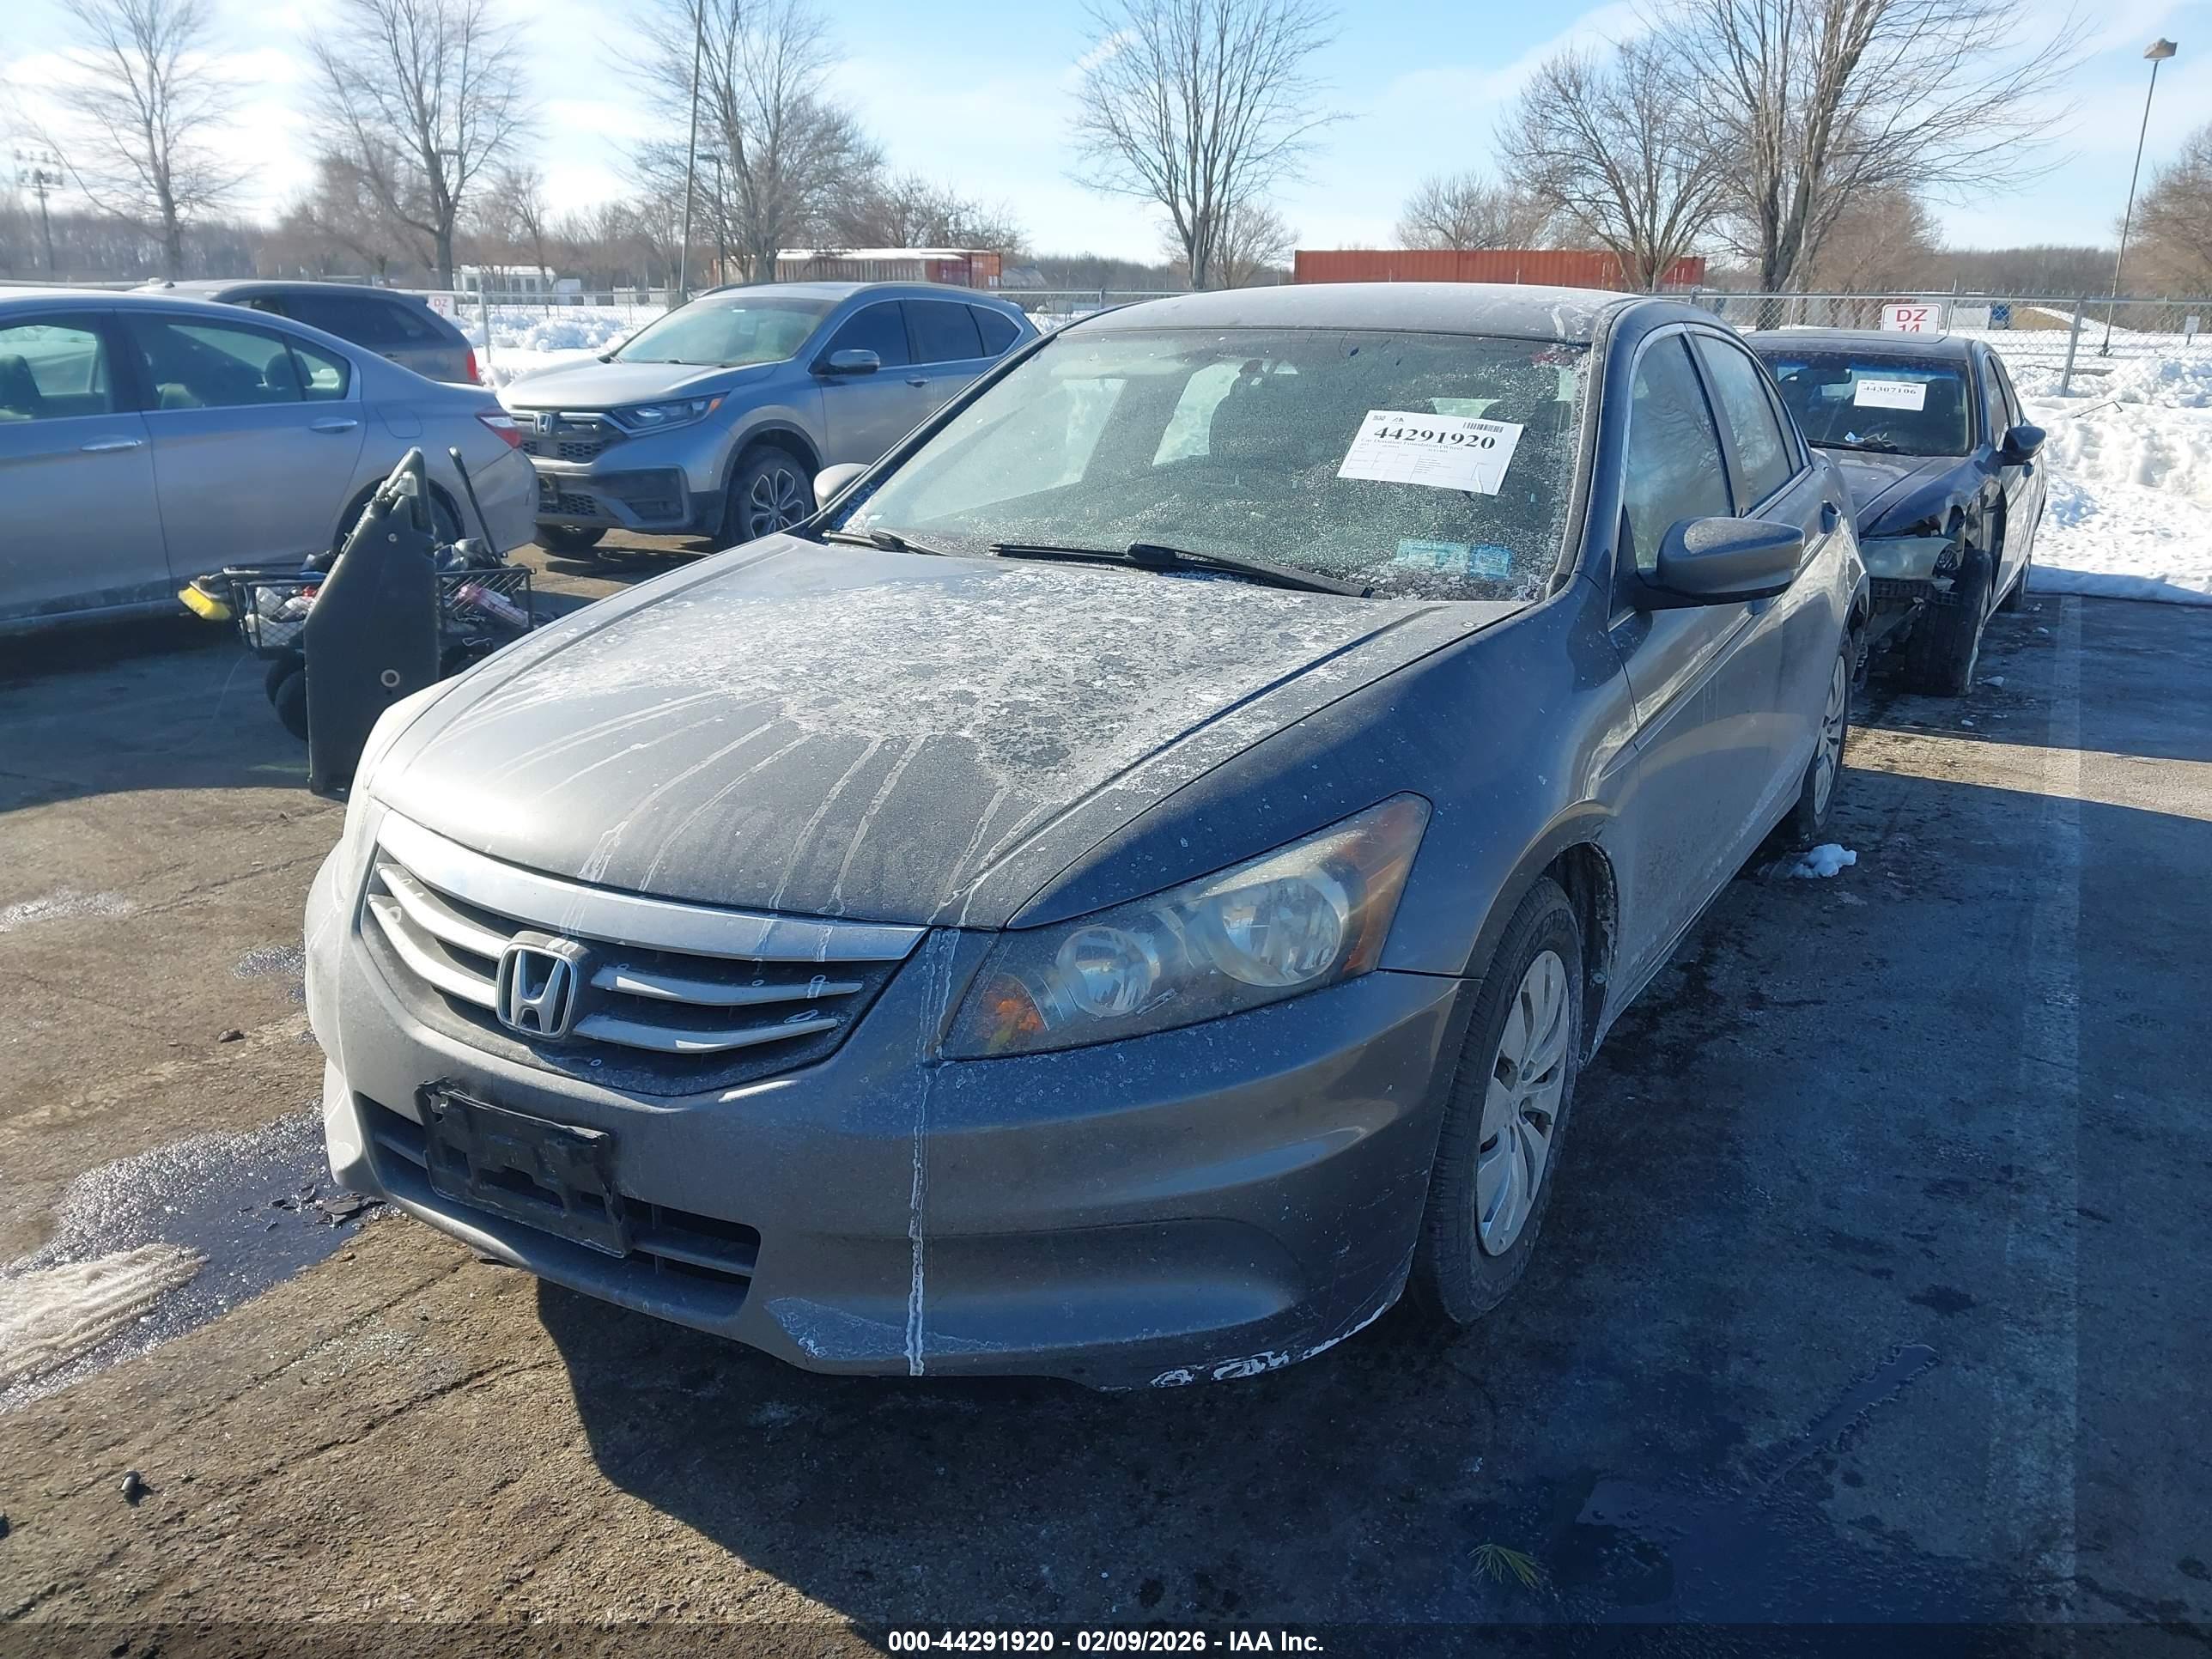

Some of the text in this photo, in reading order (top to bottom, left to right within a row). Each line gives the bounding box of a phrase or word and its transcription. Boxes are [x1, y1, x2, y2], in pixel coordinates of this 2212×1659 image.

[1896, 309, 1928, 322] DZ
[1898, 323, 1920, 332] 14
[1863, 386, 1917, 395] 44307106
[1374, 427, 1496, 449] 44291920
